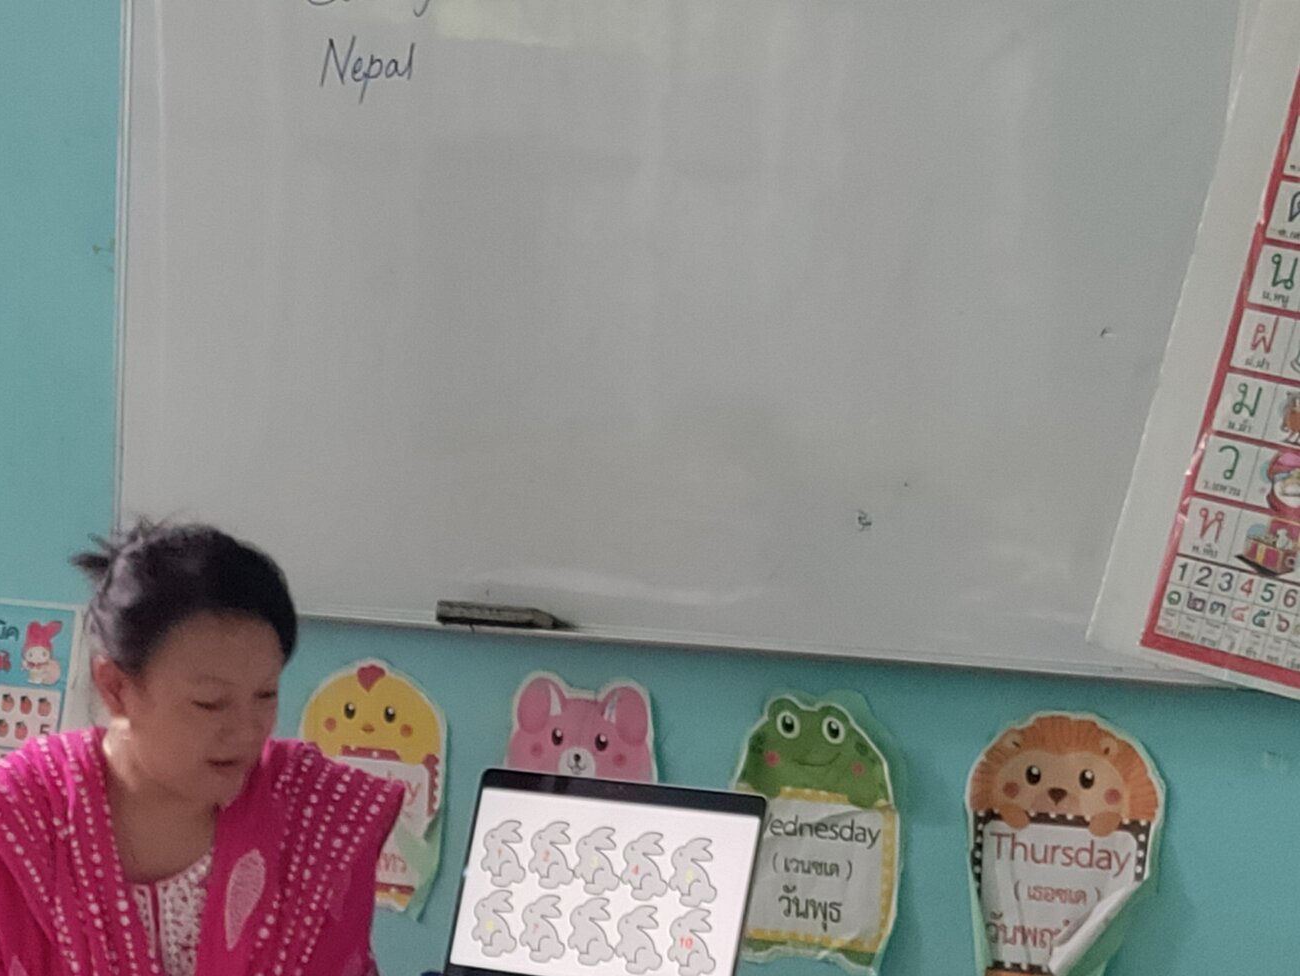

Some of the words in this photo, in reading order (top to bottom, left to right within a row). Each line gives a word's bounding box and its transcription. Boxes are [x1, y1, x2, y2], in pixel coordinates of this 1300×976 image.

[320, 35, 415, 104] Nepal
[1272, 253, 1298, 290] น
[1232, 383, 1263, 417] ม
[1218, 445, 1240, 480] ว
[1178, 563, 1188, 581] 1
[1196, 566, 1212, 587] 2
[1218, 572, 1234, 592] 3
[1240, 578, 1254, 596] 4
[1260, 583, 1277, 603] 5
[1283, 588, 1299, 608] 6
[990, 832, 1131, 878] Thursday
[778, 885, 843, 932] วันพุธ
[679, 937, 693, 950] 10
